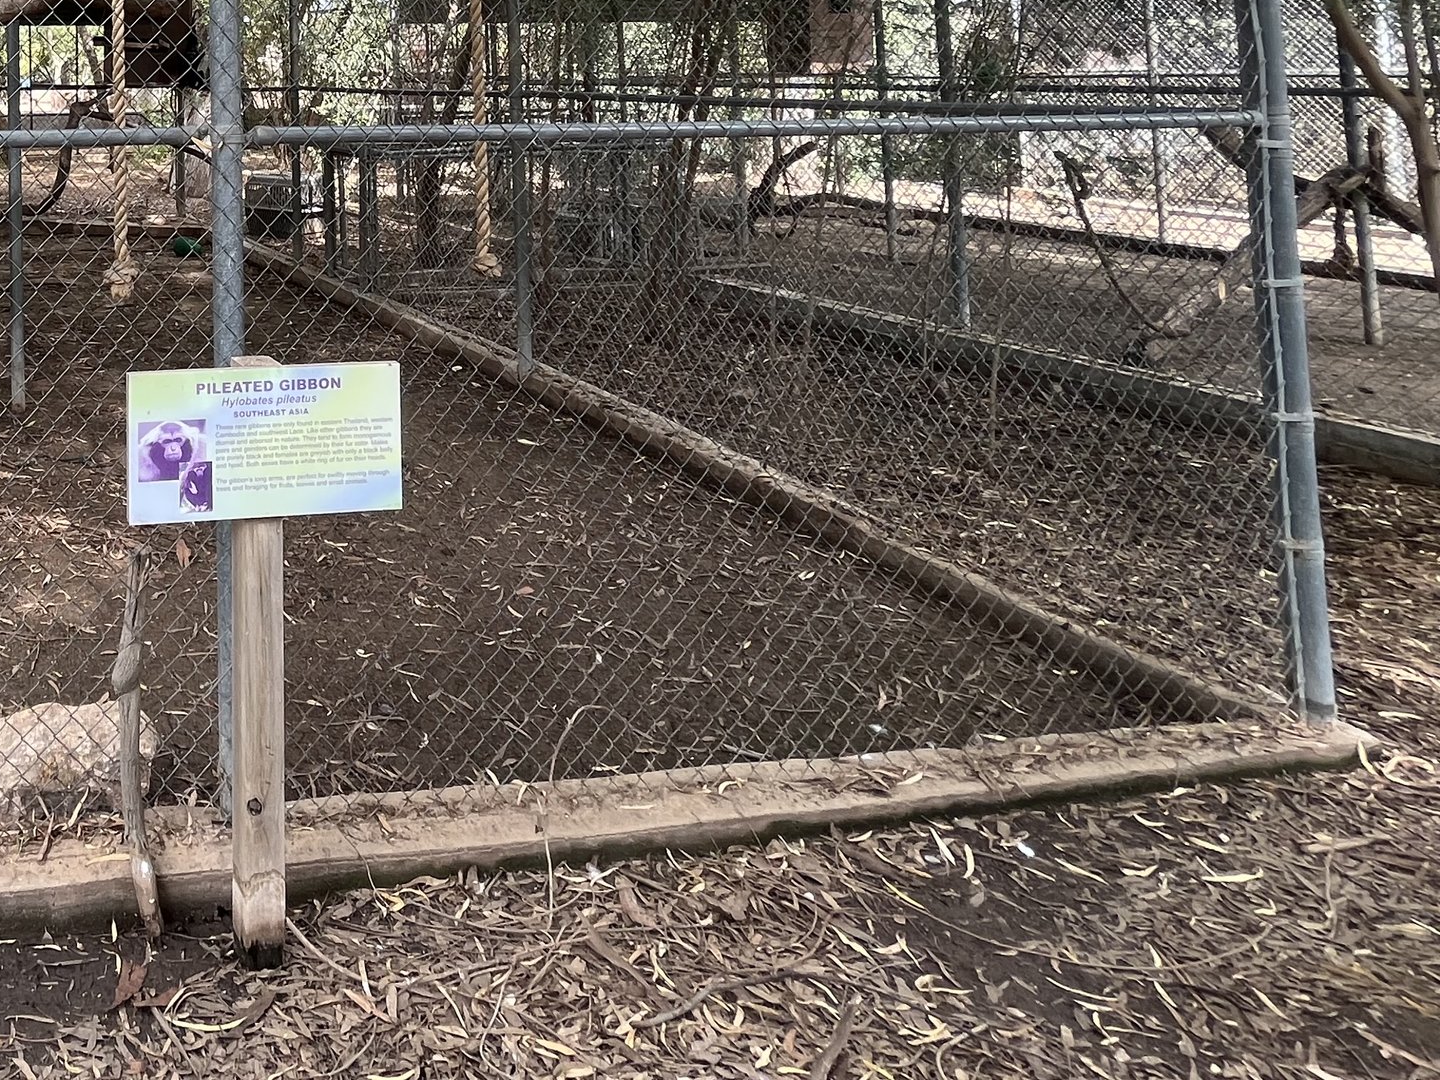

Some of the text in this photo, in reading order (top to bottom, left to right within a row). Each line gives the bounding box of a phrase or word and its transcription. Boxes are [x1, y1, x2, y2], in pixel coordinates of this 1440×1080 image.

[197, 377, 341, 394] PILEATED GIBBON
[222, 393, 317, 408] Hylobates pileatus
[234, 409, 286, 418] SOUTHEAST
[283, 421, 295, 429] only
